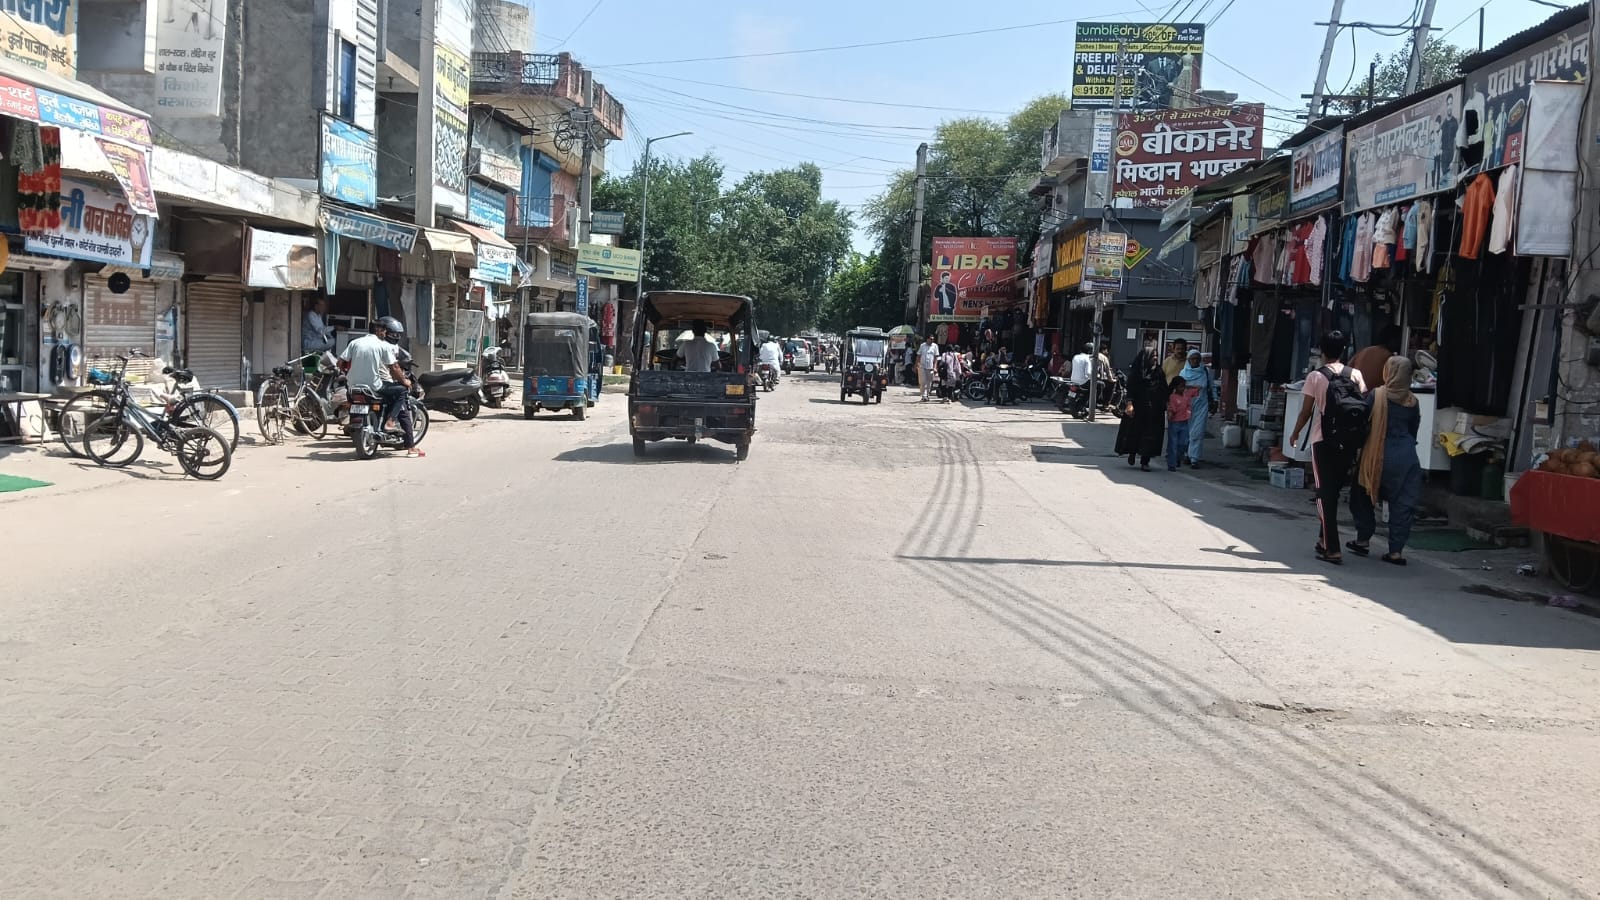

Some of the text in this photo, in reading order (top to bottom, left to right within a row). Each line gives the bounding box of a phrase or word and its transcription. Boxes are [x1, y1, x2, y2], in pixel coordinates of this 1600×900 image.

[1161, 31, 1176, 41] OFF
[1075, 53, 1102, 63] FREE
[1076, 65, 1084, 75] &
[1487, 60, 1526, 102] प्रताप
[1142, 119, 1256, 154] बीकानेर
[1115, 158, 1182, 184] मिष्ठान
[937, 254, 1010, 270] LIBAS
